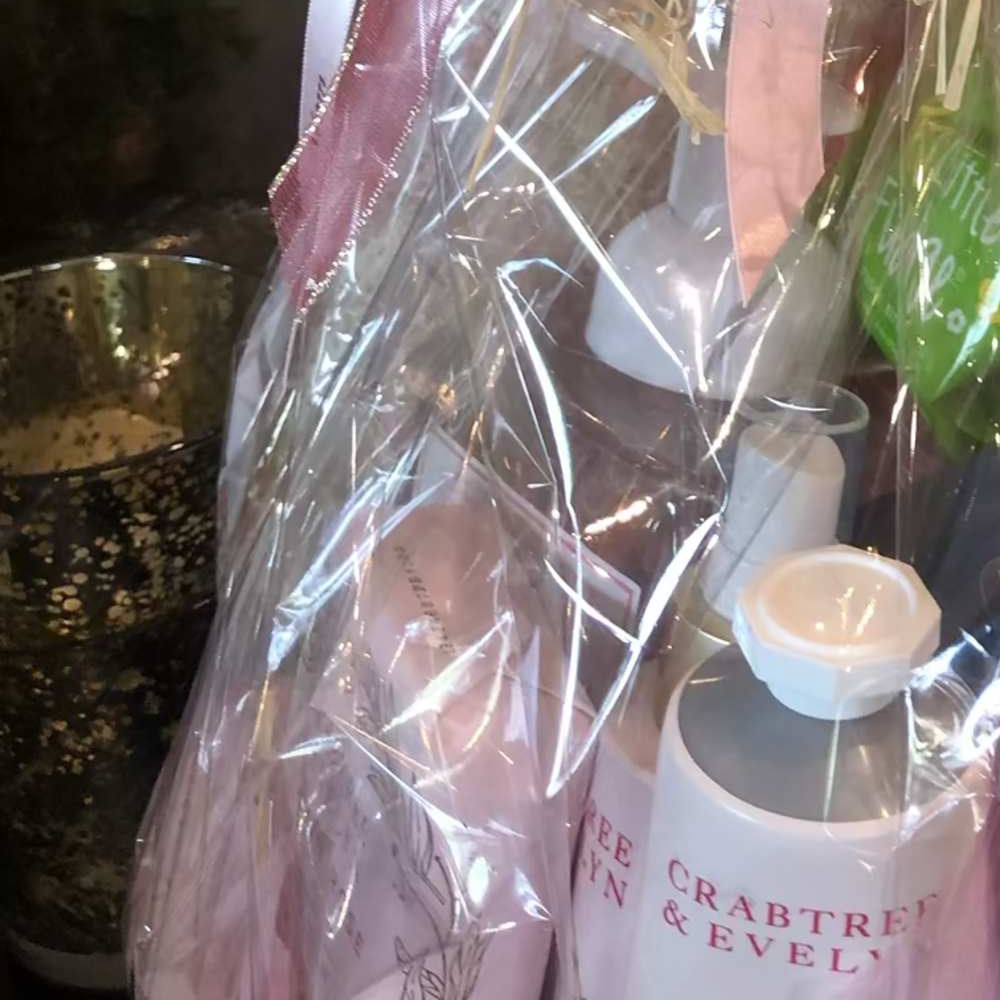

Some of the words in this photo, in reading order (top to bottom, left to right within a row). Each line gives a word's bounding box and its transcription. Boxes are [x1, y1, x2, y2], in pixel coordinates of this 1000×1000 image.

[581, 849, 629, 909] YN
[662, 898, 690, 937] &
[707, 921, 882, 975] EVEL
